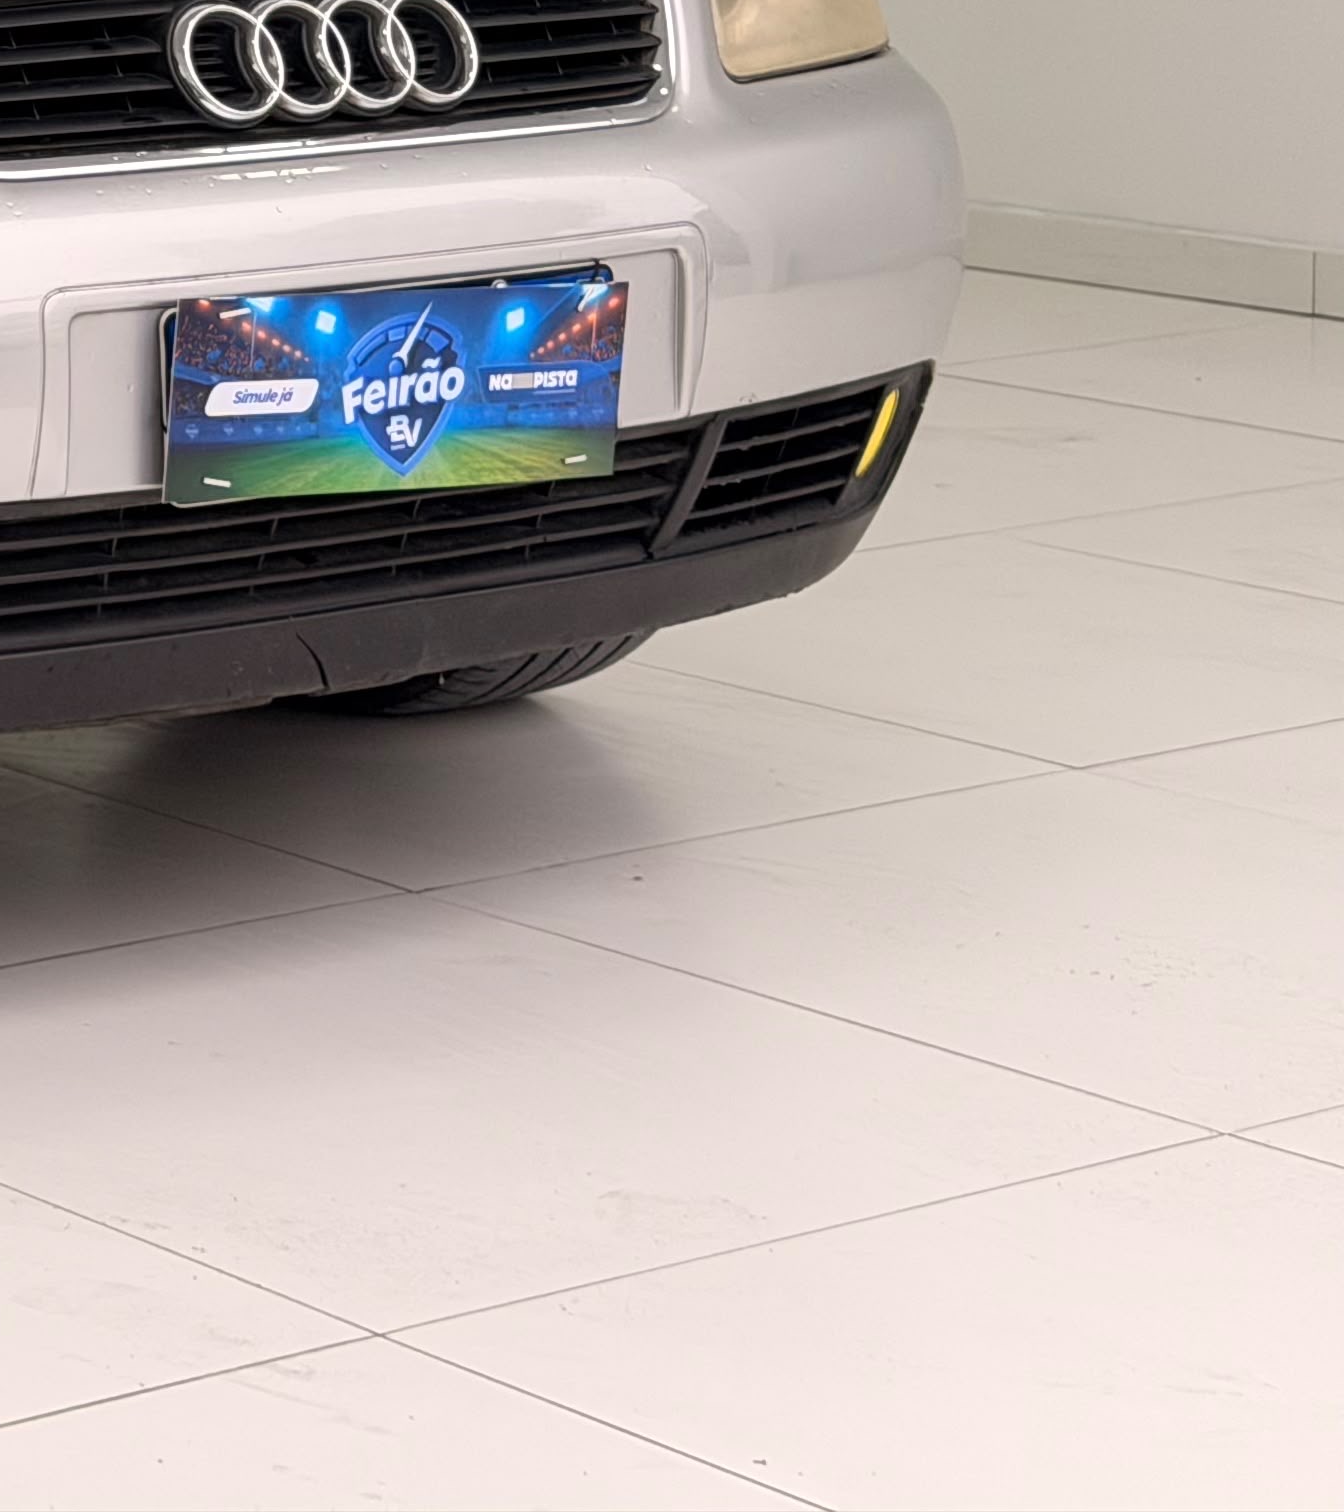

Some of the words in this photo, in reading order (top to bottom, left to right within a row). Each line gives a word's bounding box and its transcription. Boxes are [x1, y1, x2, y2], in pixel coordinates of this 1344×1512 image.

[233, 388, 278, 405] Simule
[276, 386, 295, 407] já
[341, 356, 466, 425] Feirão
